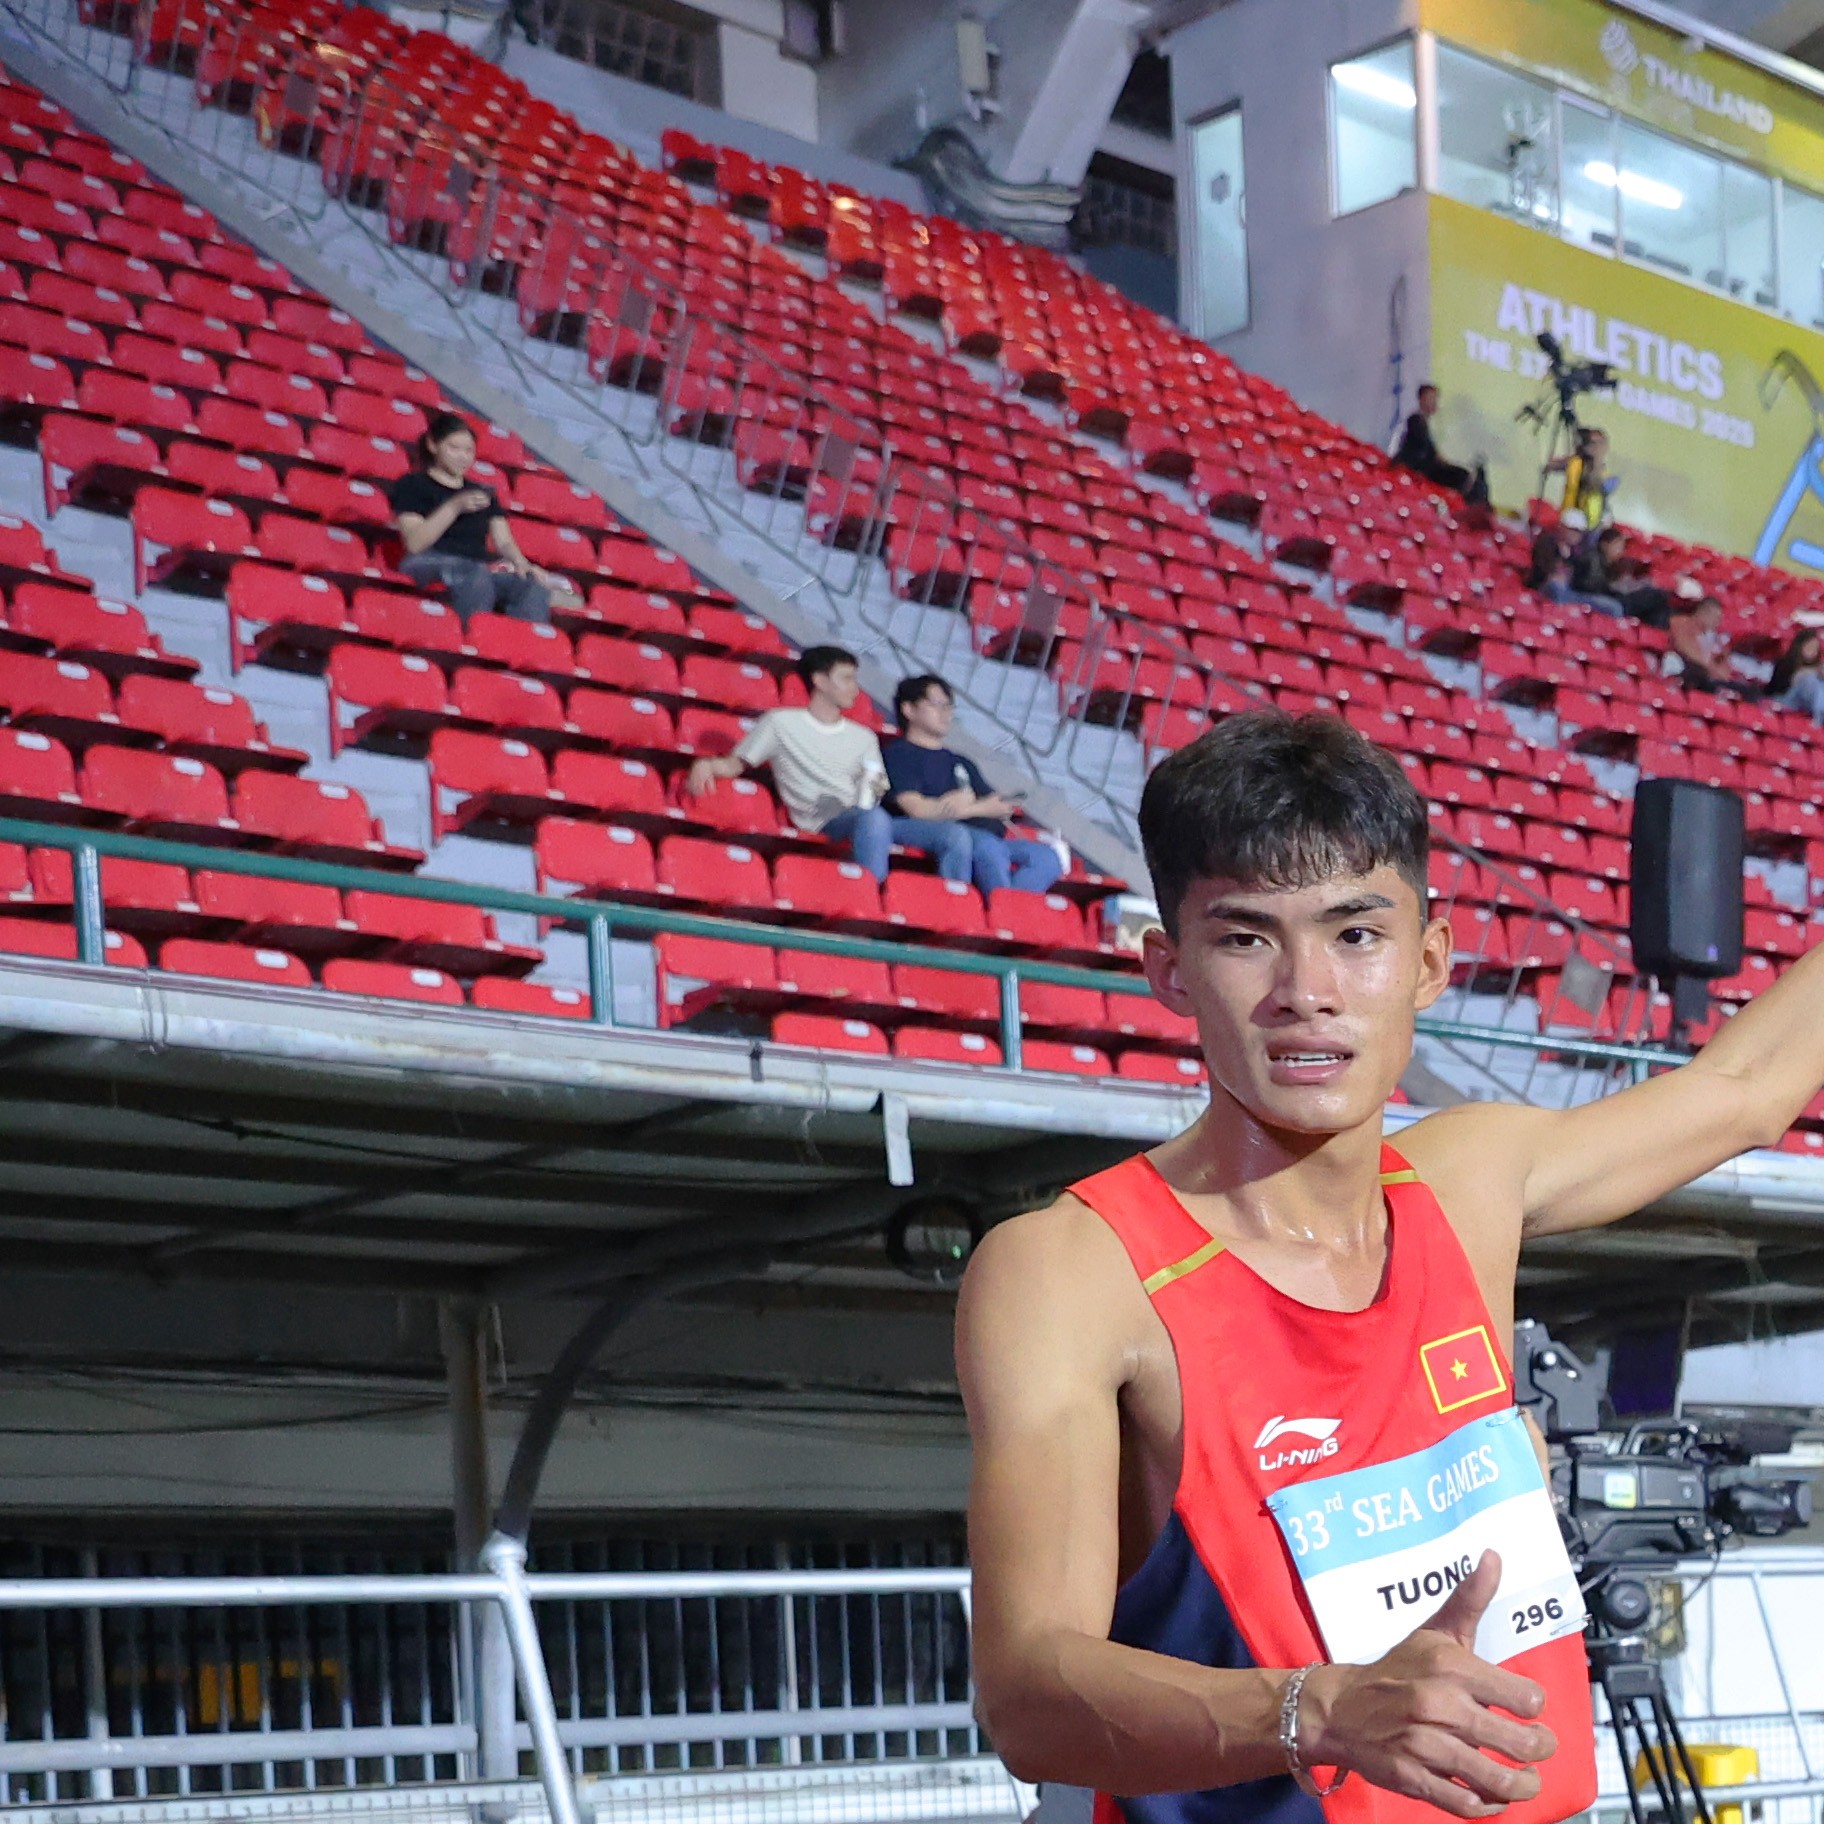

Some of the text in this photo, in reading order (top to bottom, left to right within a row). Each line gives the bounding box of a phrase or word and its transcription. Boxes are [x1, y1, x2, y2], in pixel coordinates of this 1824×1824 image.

[1642, 53, 1775, 135] THAILAND
[1496, 283, 1726, 401] ATHLETICS
[1259, 1437, 1340, 1471] LI-NING
[1289, 1444, 1500, 1556] 33rd SEA GAMES
[1377, 1554, 1473, 1611] TUONG
[1512, 1597, 1564, 1634] 296
